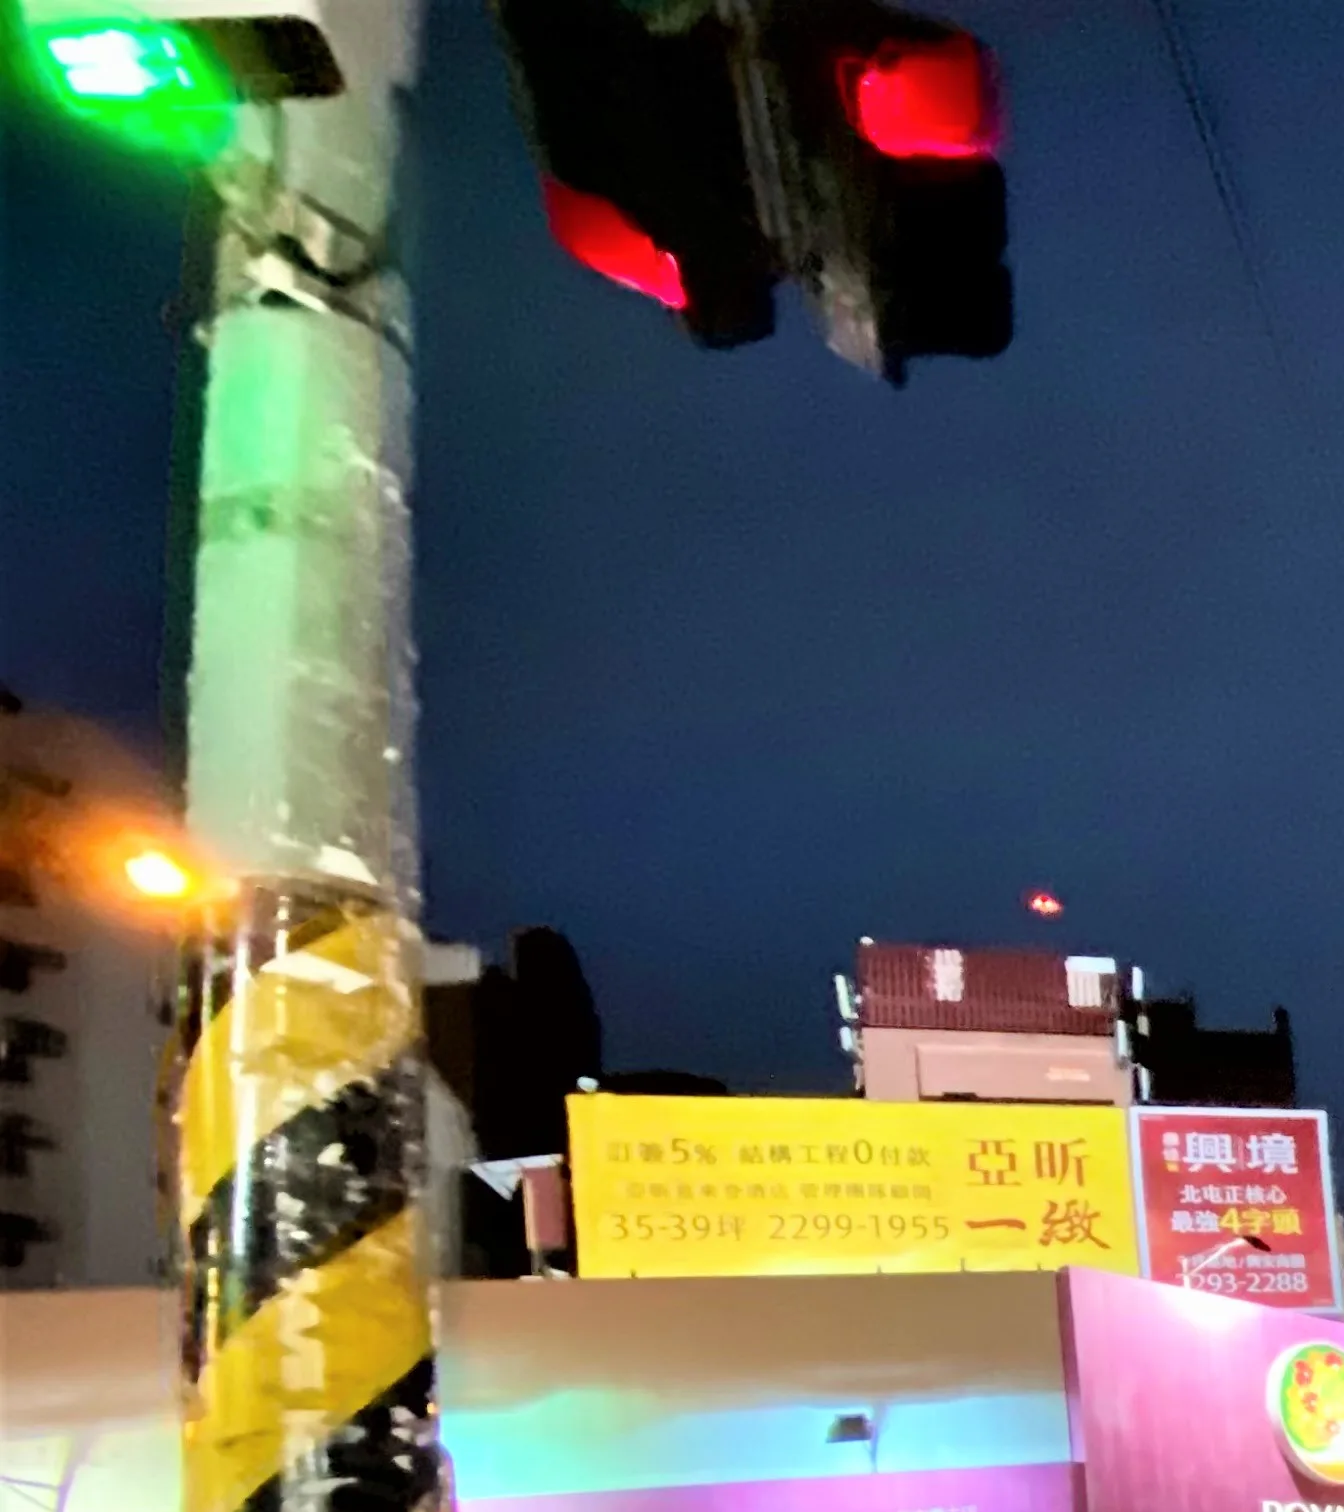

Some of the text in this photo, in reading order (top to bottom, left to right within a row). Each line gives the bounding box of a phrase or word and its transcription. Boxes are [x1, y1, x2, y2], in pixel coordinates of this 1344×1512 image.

[965, 1138, 1091, 1188] 亞昕
[1180, 1184, 1287, 1206] 北屯正核心
[611, 1213, 950, 1242] 35-39坪 2299-1955
[1170, 1208, 1303, 1236] 最強4字頭
